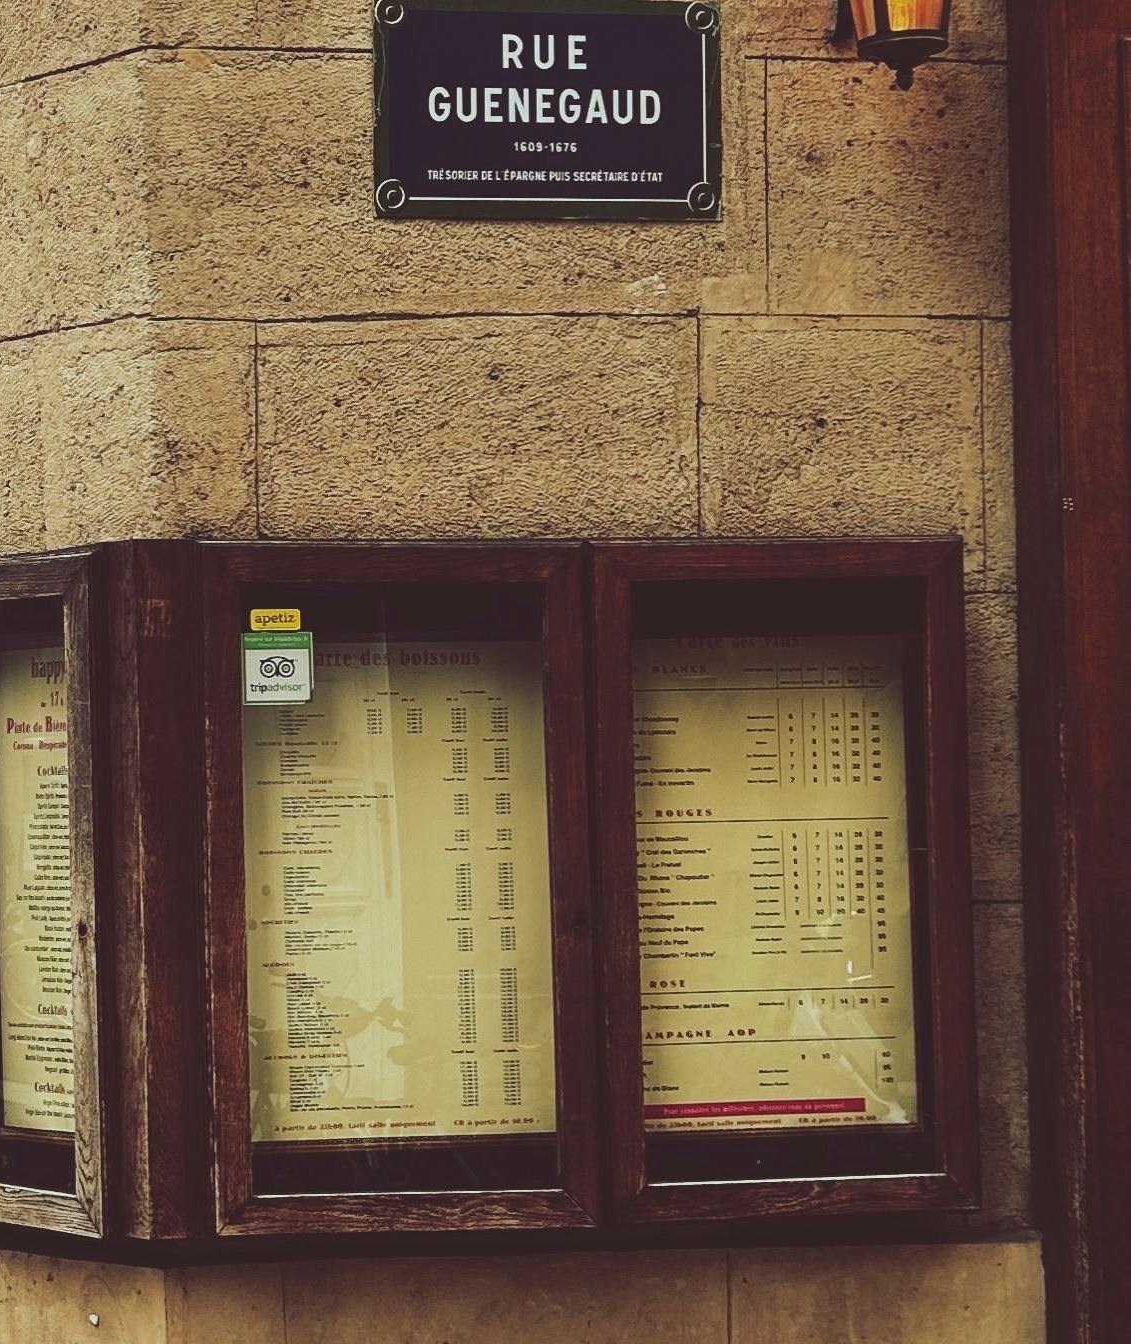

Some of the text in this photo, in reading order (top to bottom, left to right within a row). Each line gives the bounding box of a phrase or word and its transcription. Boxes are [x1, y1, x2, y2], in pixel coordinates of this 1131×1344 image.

[502, 34, 587, 69] RUE
[428, 86, 661, 124] GUENEGAUD
[514, 142, 578, 153] 1609-1676
[427, 168, 479, 181] TRÉSORIER
[481, 170, 493, 181] DE
[549, 172, 570, 182] PUIS
[573, 169, 629, 182] SECRÉTAIRE
[254, 613, 295, 626] apetiz
[250, 682, 303, 694] tripadvisor
[6, 717, 31, 734] Pinte
[33, 722, 43, 733] de
[655, 809, 713, 817] ROUGES
[649, 980, 685, 988] ROSE
[37, 1003, 68, 1016] Cocktails
[34, 1081, 66, 1094] Cocktails
